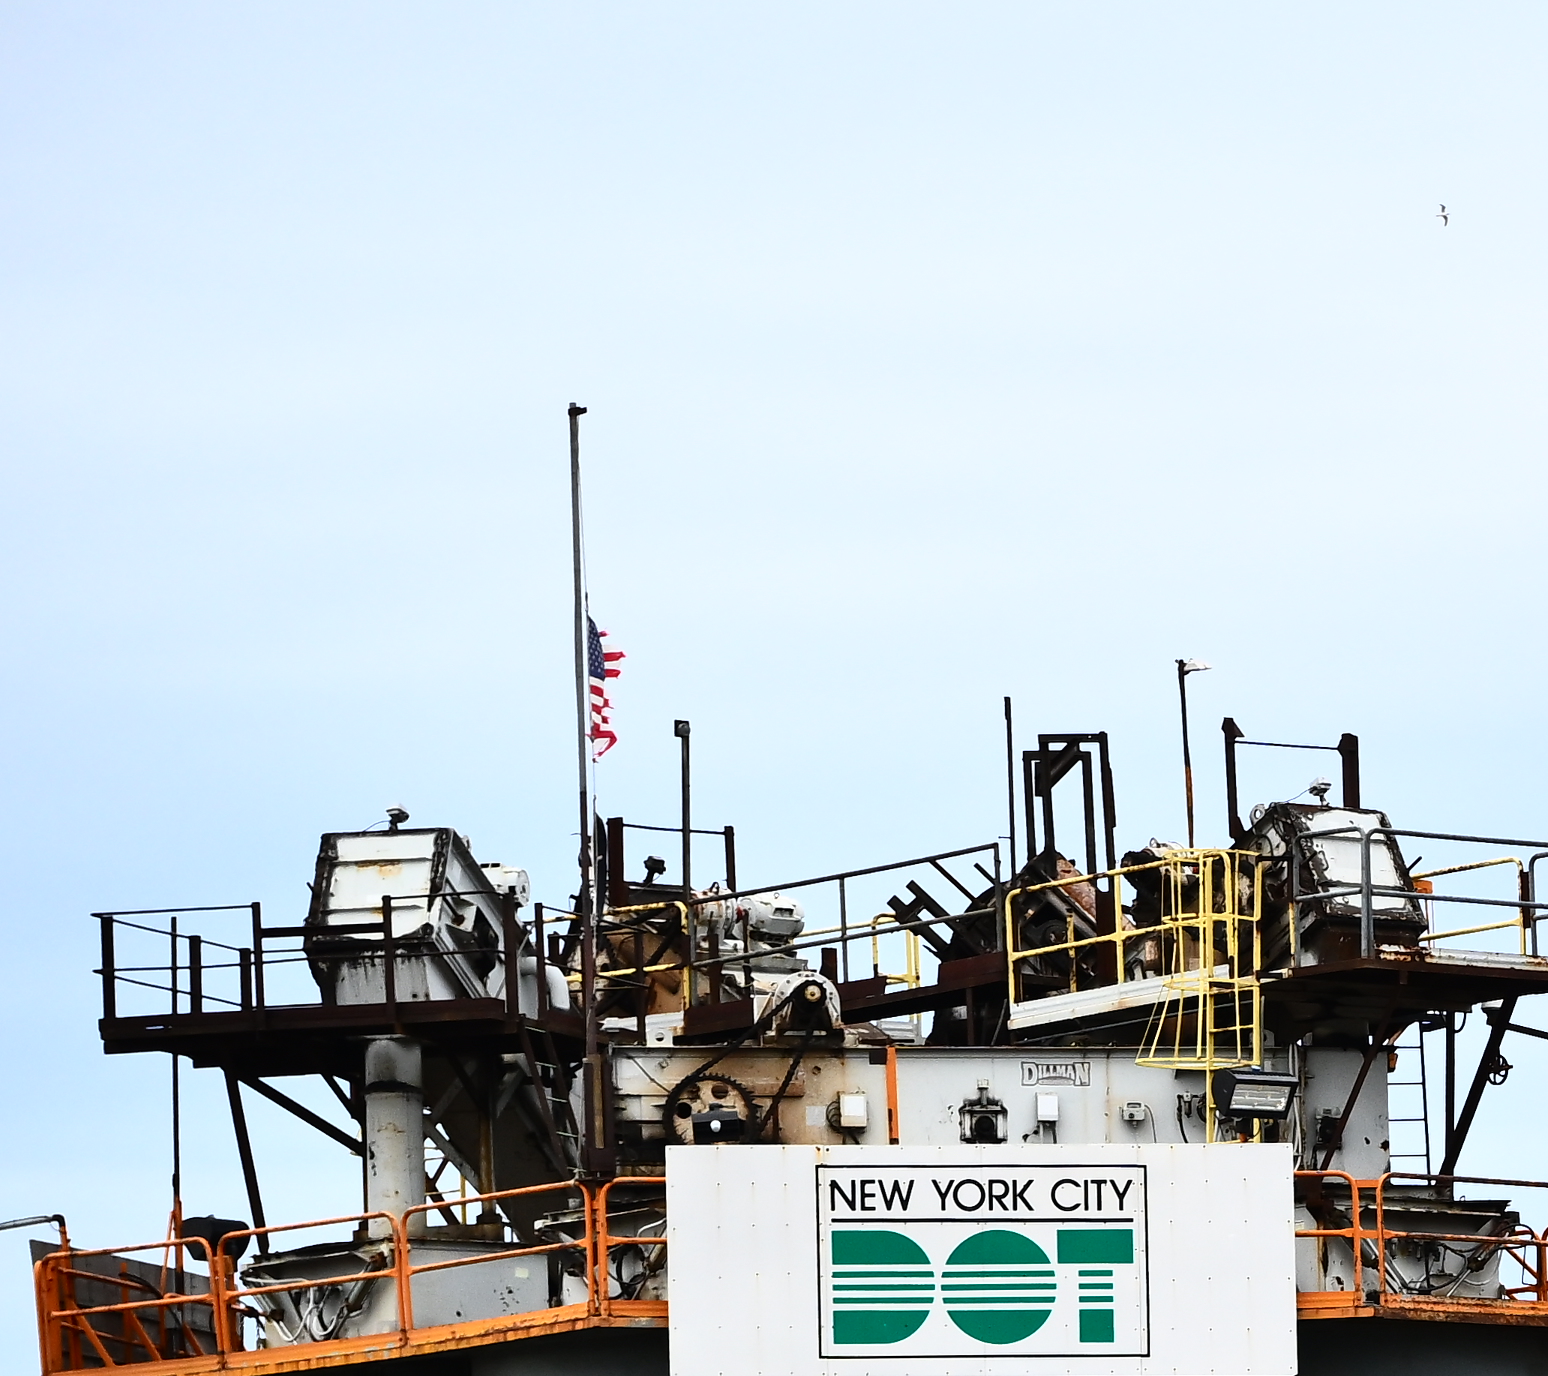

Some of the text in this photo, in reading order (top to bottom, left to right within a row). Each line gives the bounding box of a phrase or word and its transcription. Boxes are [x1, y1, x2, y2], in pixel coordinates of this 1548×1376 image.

[829, 1178, 1134, 1212] NEW YORK CITY
[831, 1229, 1134, 1345] DOT
